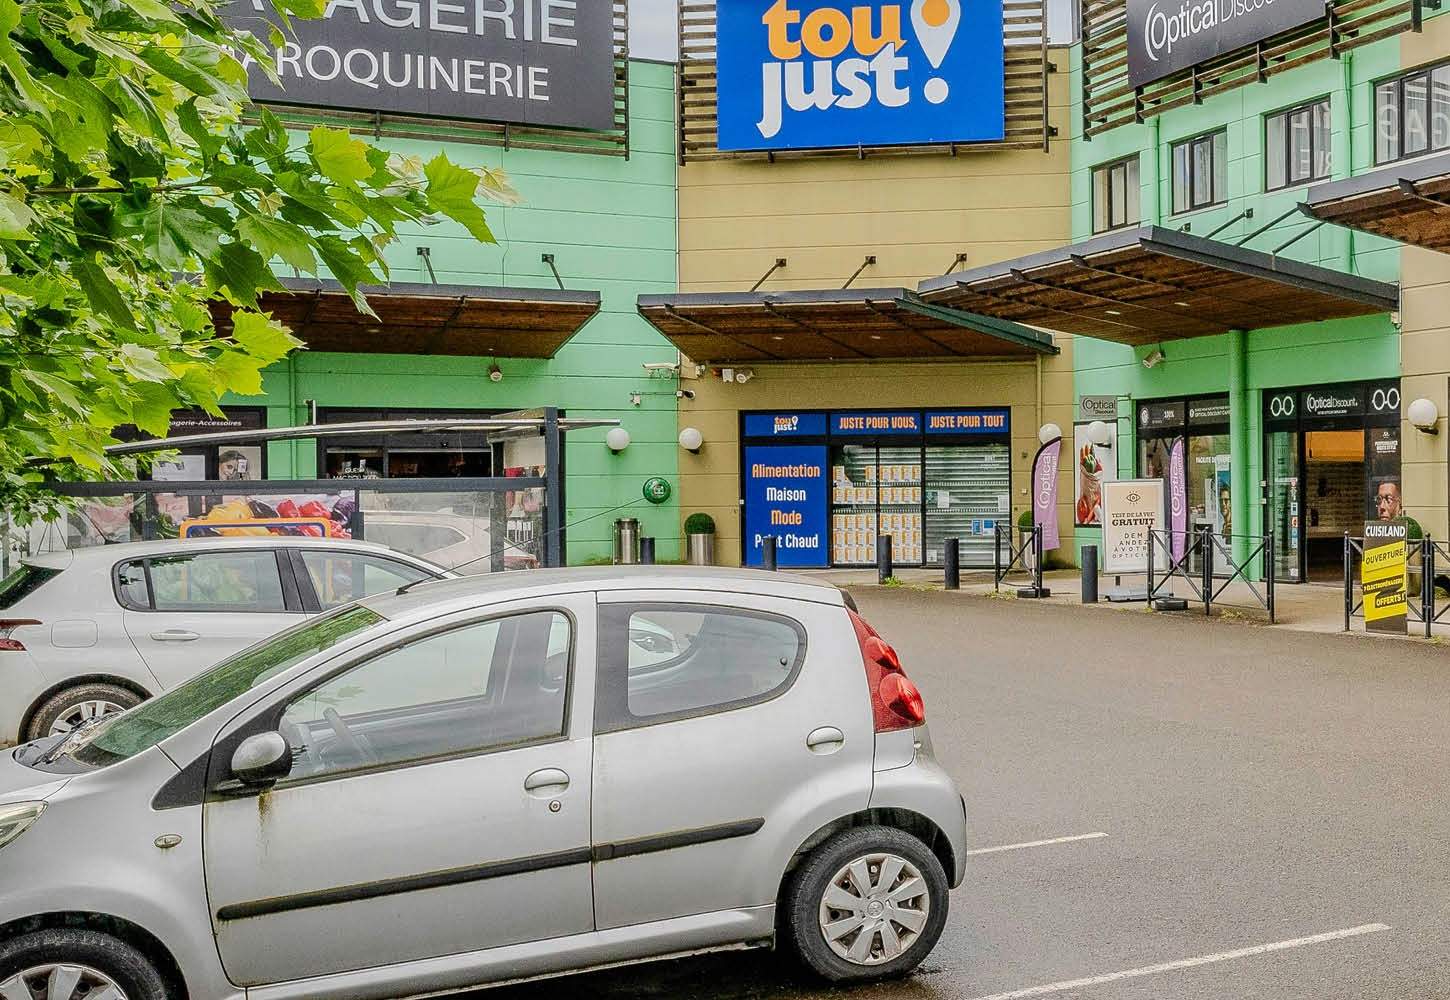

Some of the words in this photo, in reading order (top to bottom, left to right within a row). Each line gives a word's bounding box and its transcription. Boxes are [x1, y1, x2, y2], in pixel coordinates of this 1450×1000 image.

[220, 40, 551, 102] ROQUINERIE
[839, 417, 864, 430] JUSTE
[866, 417, 889, 430] POUR
[891, 416, 918, 430] VOUS,
[929, 416, 955, 429] JUSTE
[957, 416, 980, 428] POUR
[982, 415, 1005, 428] TOUT
[752, 463, 821, 479] Alimentation
[766, 486, 807, 502] Maison
[770, 509, 802, 525] Mode
[1111, 518, 1155, 526] GRATUIT
[1365, 525, 1406, 537] CUISILAND
[785, 533, 819, 549] Chaud
[1365, 548, 1404, 565] OUVERTURE
[1375, 594, 1401, 607] OFFERTS
